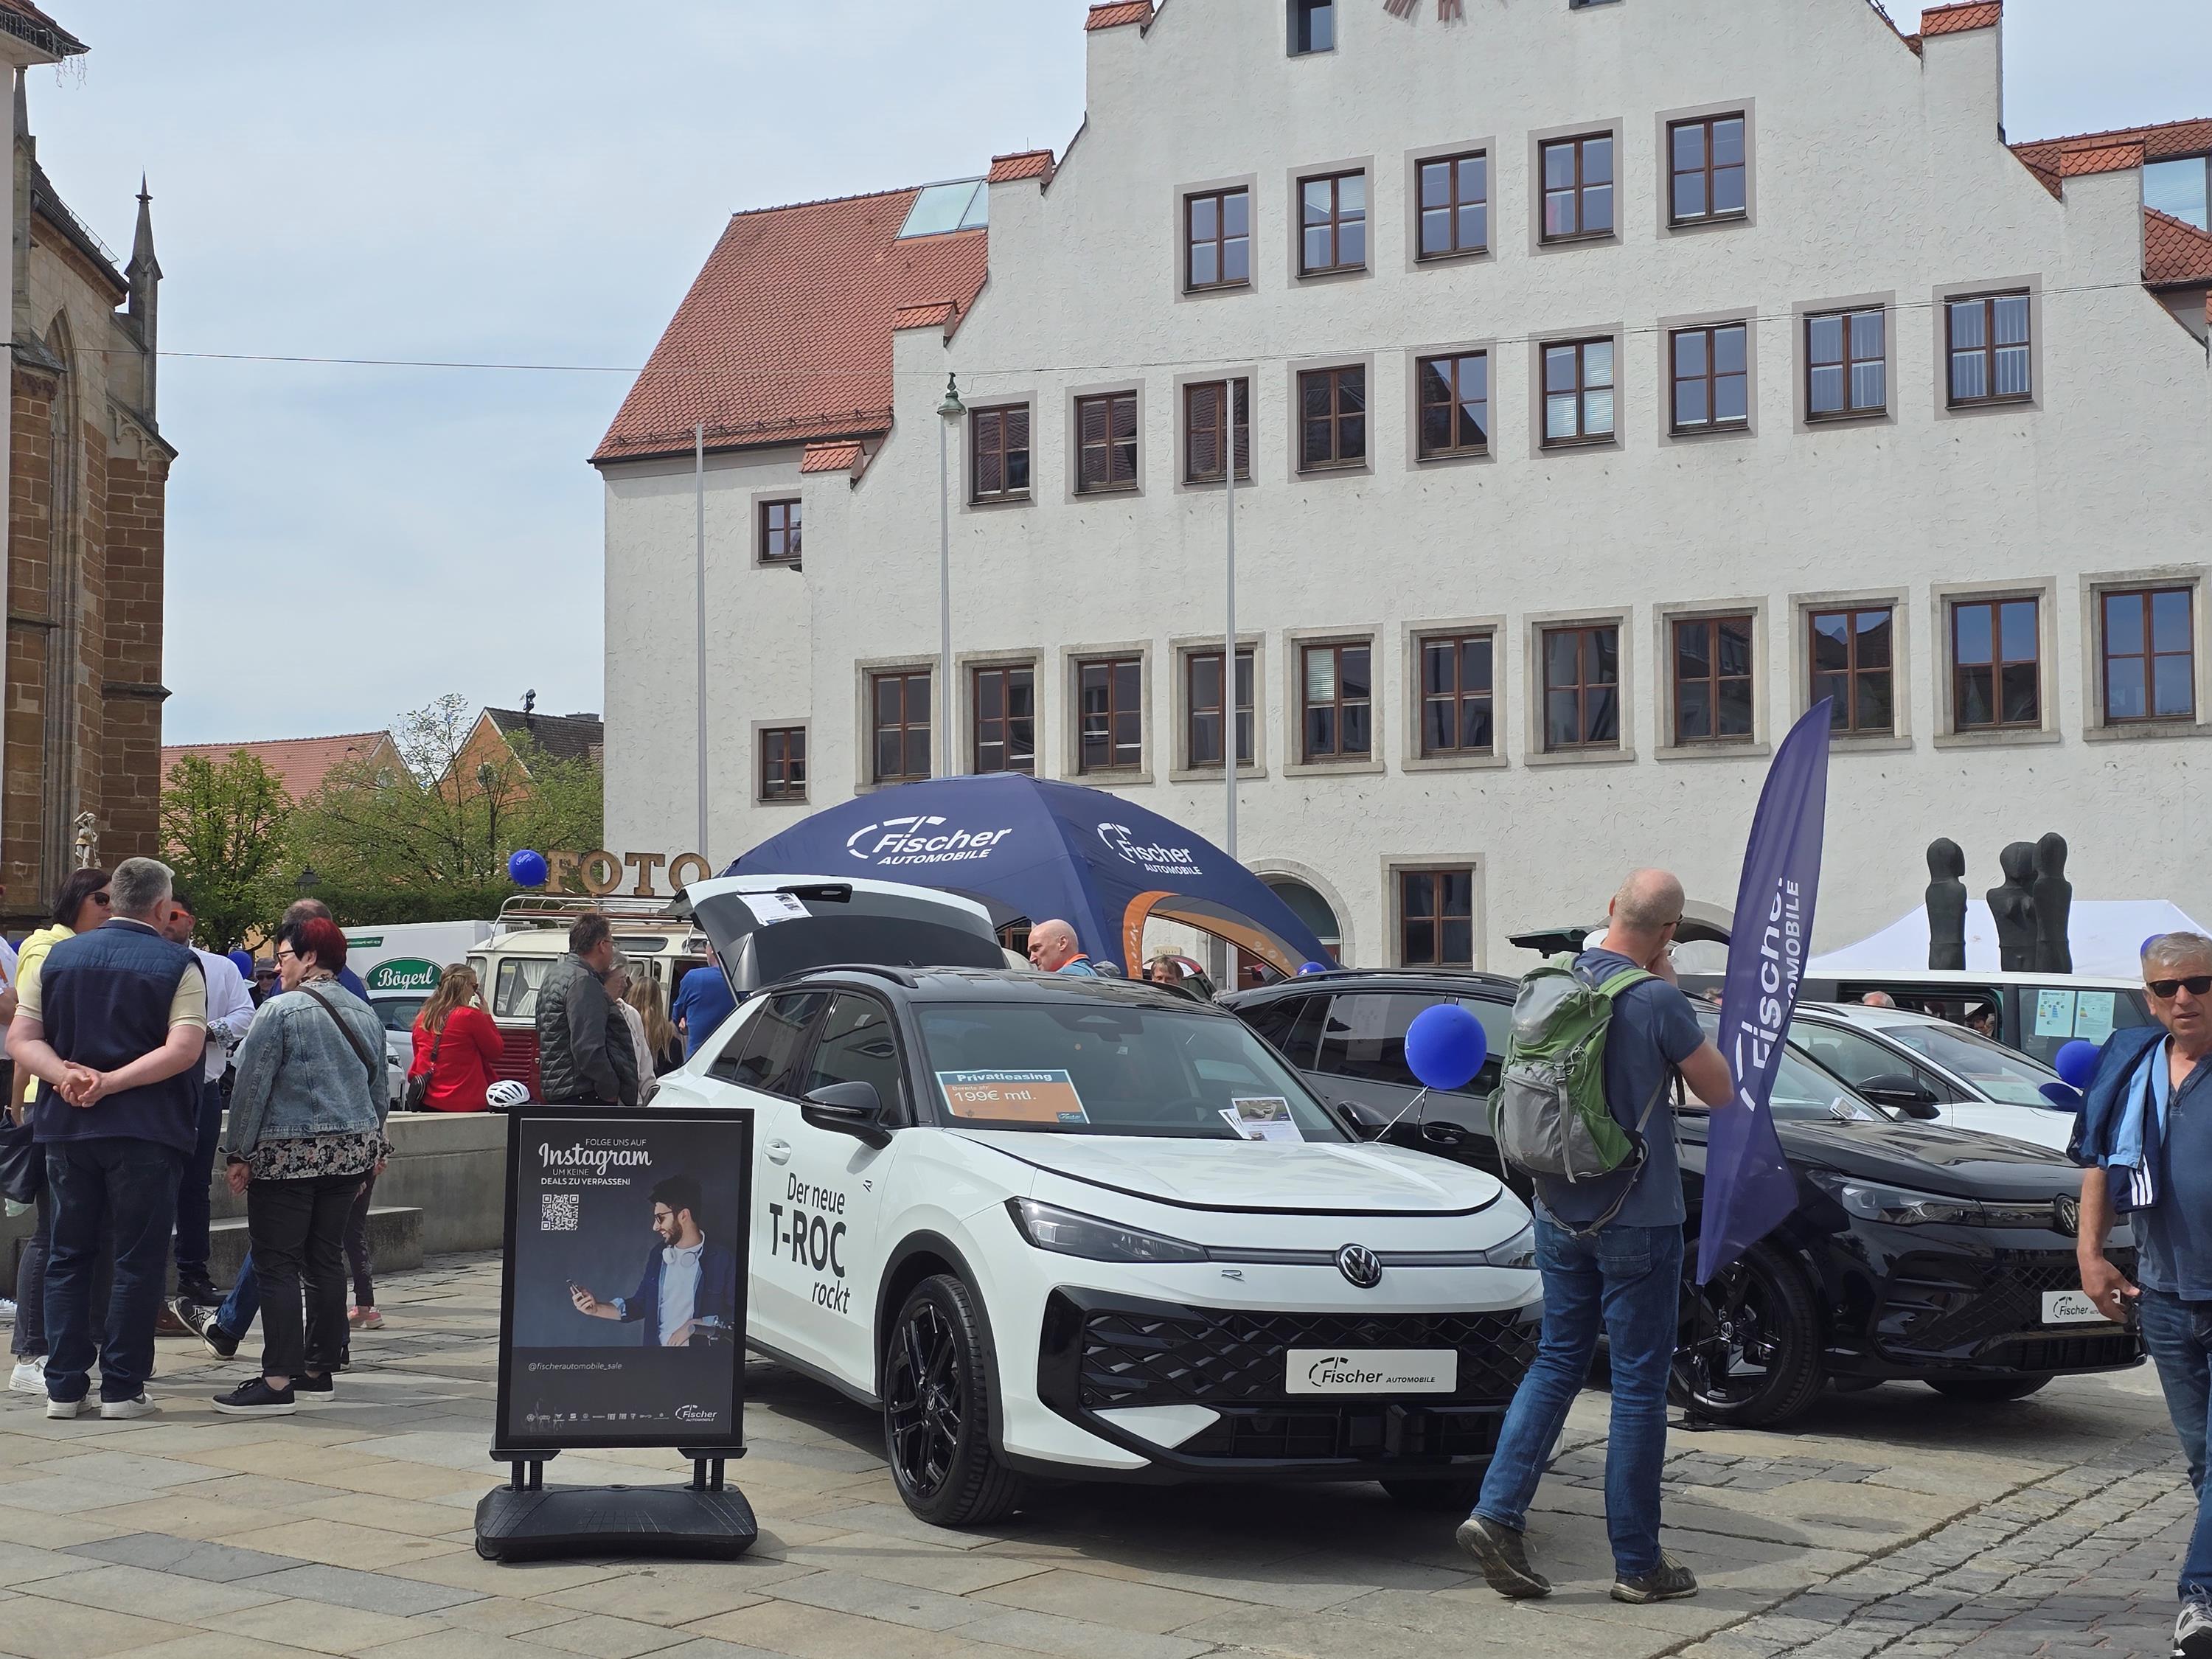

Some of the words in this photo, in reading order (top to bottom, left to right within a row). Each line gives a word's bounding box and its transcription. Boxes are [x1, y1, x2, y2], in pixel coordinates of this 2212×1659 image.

[872, 828, 1013, 854] Fischer
[1116, 839, 1193, 863] Fischer
[877, 848, 992, 866] AUTOMOBILE
[545, 849, 712, 897] FOTO
[1144, 863, 1203, 875] AUTOMOBILE
[1785, 880, 1801, 1009] OMOBILE
[378, 965, 434, 990] Bögerl
[1752, 877, 1783, 1069] Fische
[956, 1073, 1053, 1082] Privatleasing
[955, 1090, 1000, 1102] 199€
[1004, 1090, 1037, 1102] mtl.
[585, 1138, 611, 1147] FOLGE
[613, 1138, 630, 1147] UNS
[630, 1138, 647, 1147] AUF
[538, 1142, 653, 1176] Instagram
[540, 1178, 567, 1186] DEALS
[568, 1178, 580, 1186] ZU
[581, 1178, 630, 1186] VERPASSEN!
[787, 1172, 810, 1205] Der
[812, 1186, 845, 1215] neue
[769, 1203, 847, 1279] T-ROC
[812, 1280, 850, 1315] rockt
[2059, 1304, 2089, 1315] Fischer
[528, 1363, 622, 1371] @fischerautomobile_sale
[1321, 1369, 1383, 1383] Fischer
[682, 1410, 717, 1419] Fischer
